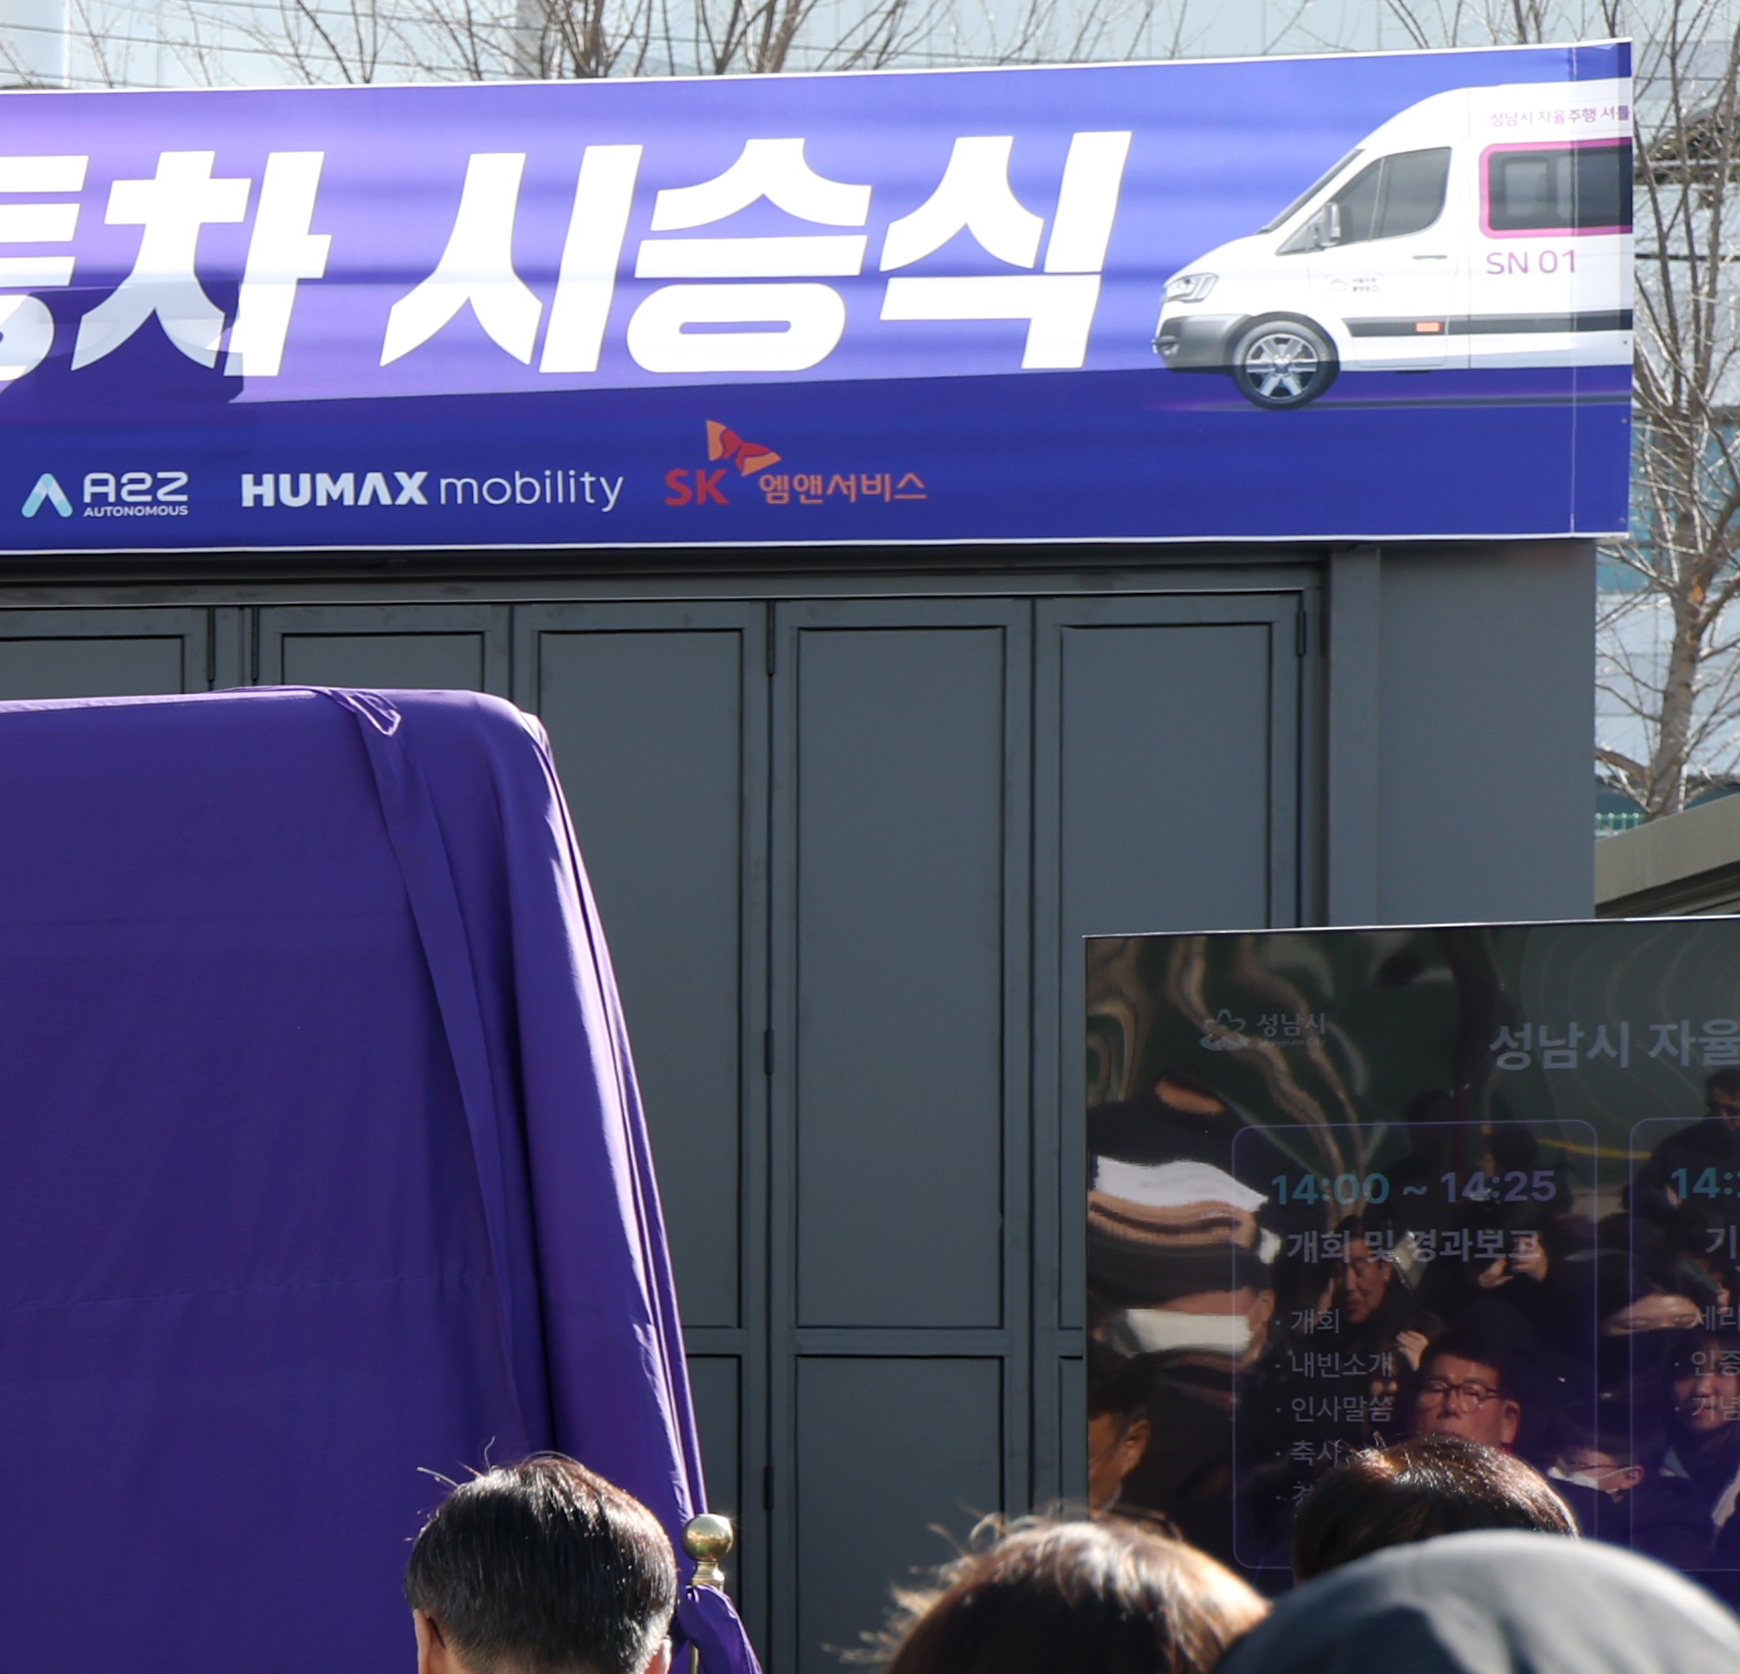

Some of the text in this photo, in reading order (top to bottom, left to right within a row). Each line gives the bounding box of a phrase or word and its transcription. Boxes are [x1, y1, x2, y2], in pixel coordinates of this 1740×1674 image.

[381, 131, 1132, 373] 시승식
[1486, 250, 1575, 275] SN 01
[242, 469, 624, 513] HUMAX mobility
[664, 468, 928, 506] SK 엠앤서비스
[83, 504, 189, 517] AUTONOMOUS
[1256, 1013, 1325, 1037] 성남시
[1489, 1018, 1740, 1071] 성남시 자율
[1271, 1173, 1390, 1205] 14:00
[1440, 1171, 1556, 1202] 14:25
[1671, 1168, 1740, 1199] 14:
[1287, 1229, 1351, 1264] 개회
[1290, 1309, 1340, 1335] 개회
[1291, 1351, 1394, 1378] 내빈소개
[1291, 1396, 1394, 1423] 인사말씀
